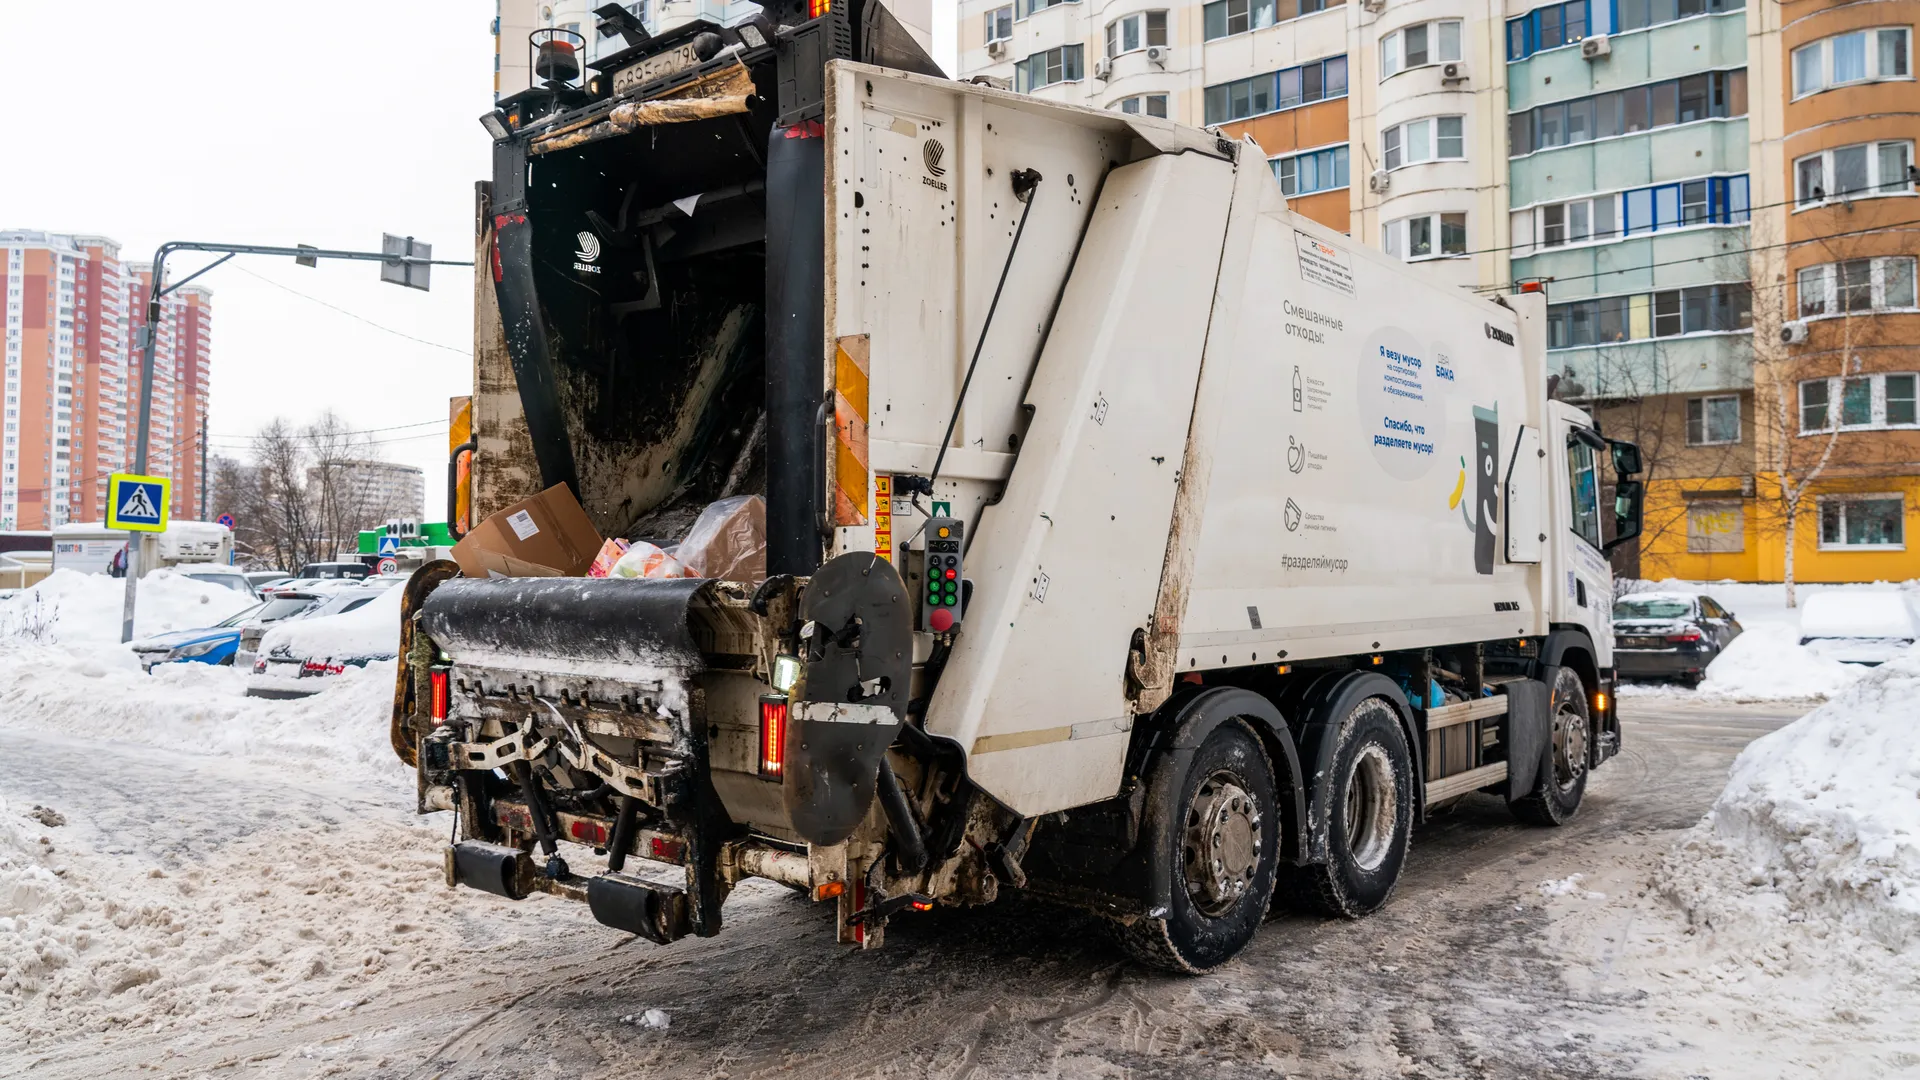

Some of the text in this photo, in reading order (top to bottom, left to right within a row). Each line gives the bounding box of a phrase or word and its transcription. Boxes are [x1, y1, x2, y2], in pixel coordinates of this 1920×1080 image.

[922, 176, 948, 192] ZOELLER
[1283, 299, 1343, 331] Смешанные
[1285, 322, 1325, 344] отходы:
[1379, 345, 1422, 369] Я везу мусор
[1386, 363, 1393, 371] на
[1435, 364, 1455, 382] БАКА
[1384, 374, 1422, 390] компостирование
[1384, 416, 1425, 435] Спасибо, что
[1374, 434, 1434, 456] разделяете мусор!
[382, 563, 395, 573] 20
[1281, 554, 1349, 573] #разделяймусор
